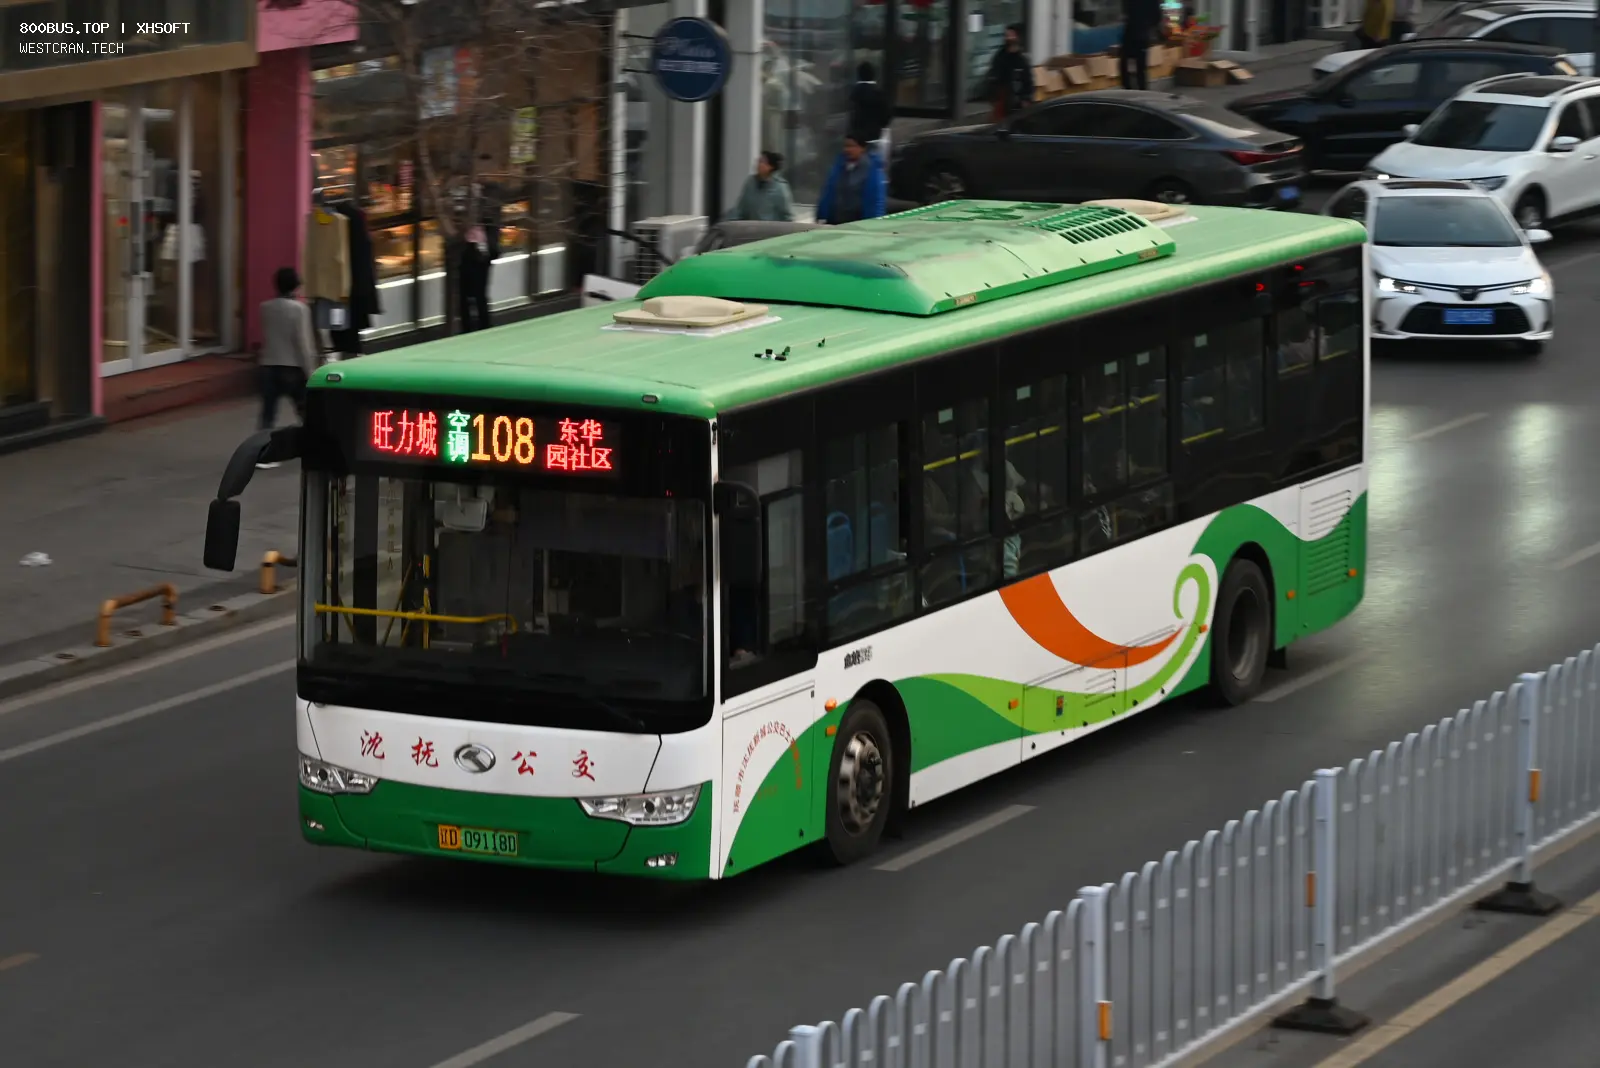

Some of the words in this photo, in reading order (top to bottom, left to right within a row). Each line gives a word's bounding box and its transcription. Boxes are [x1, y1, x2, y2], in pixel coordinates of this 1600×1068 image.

[372, 410, 438, 456] 旺力城
[446, 409, 471, 462] 空调
[472, 414, 535, 464] 108
[558, 417, 603, 447] 东华
[546, 443, 613, 471] 园社区
